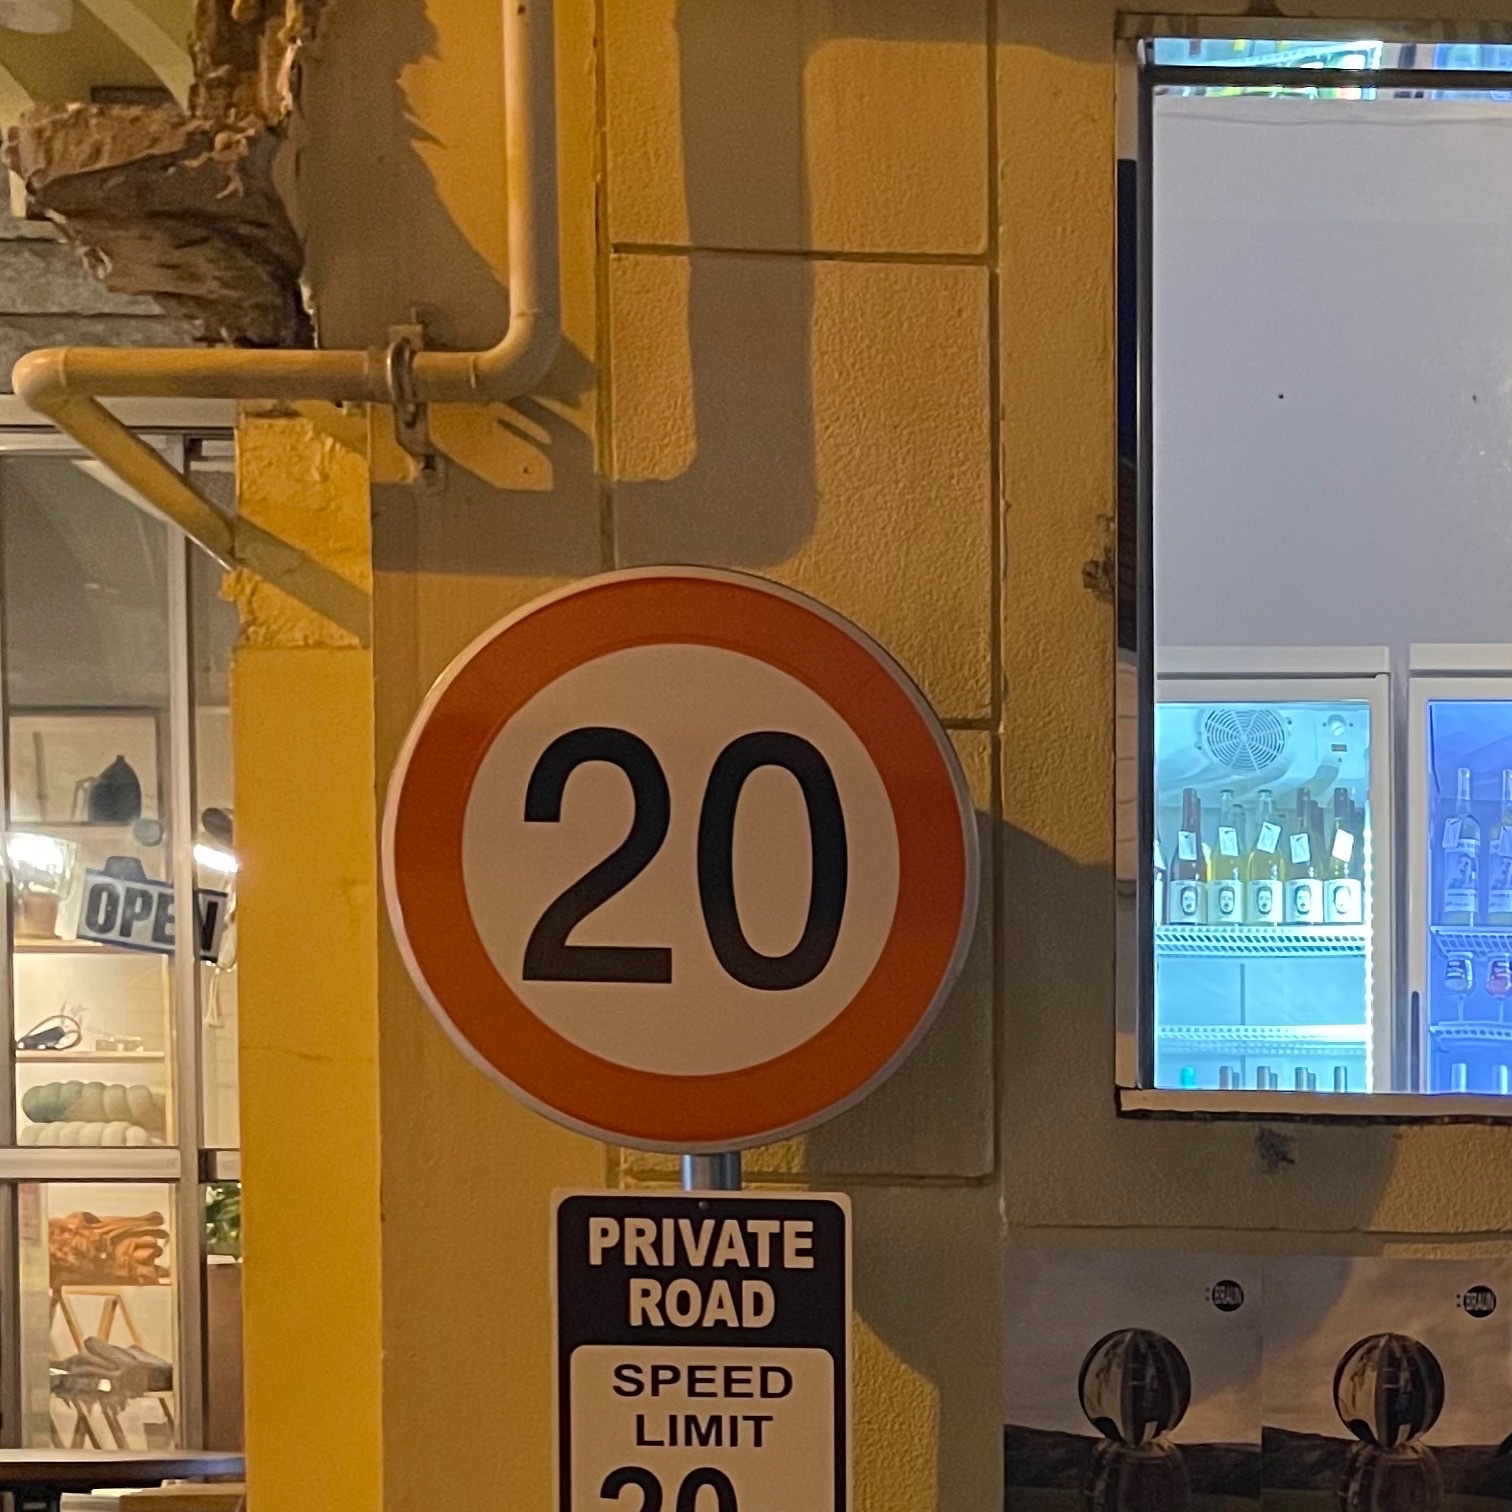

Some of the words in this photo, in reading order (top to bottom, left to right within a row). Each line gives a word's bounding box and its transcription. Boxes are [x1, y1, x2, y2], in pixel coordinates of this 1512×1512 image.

[521, 725, 848, 991] 20
[588, 1216, 814, 1269] PRIVATE
[629, 1278, 775, 1328] ROAD
[612, 1363, 793, 1399] SPEED
[636, 1413, 774, 1448] LIMIT
